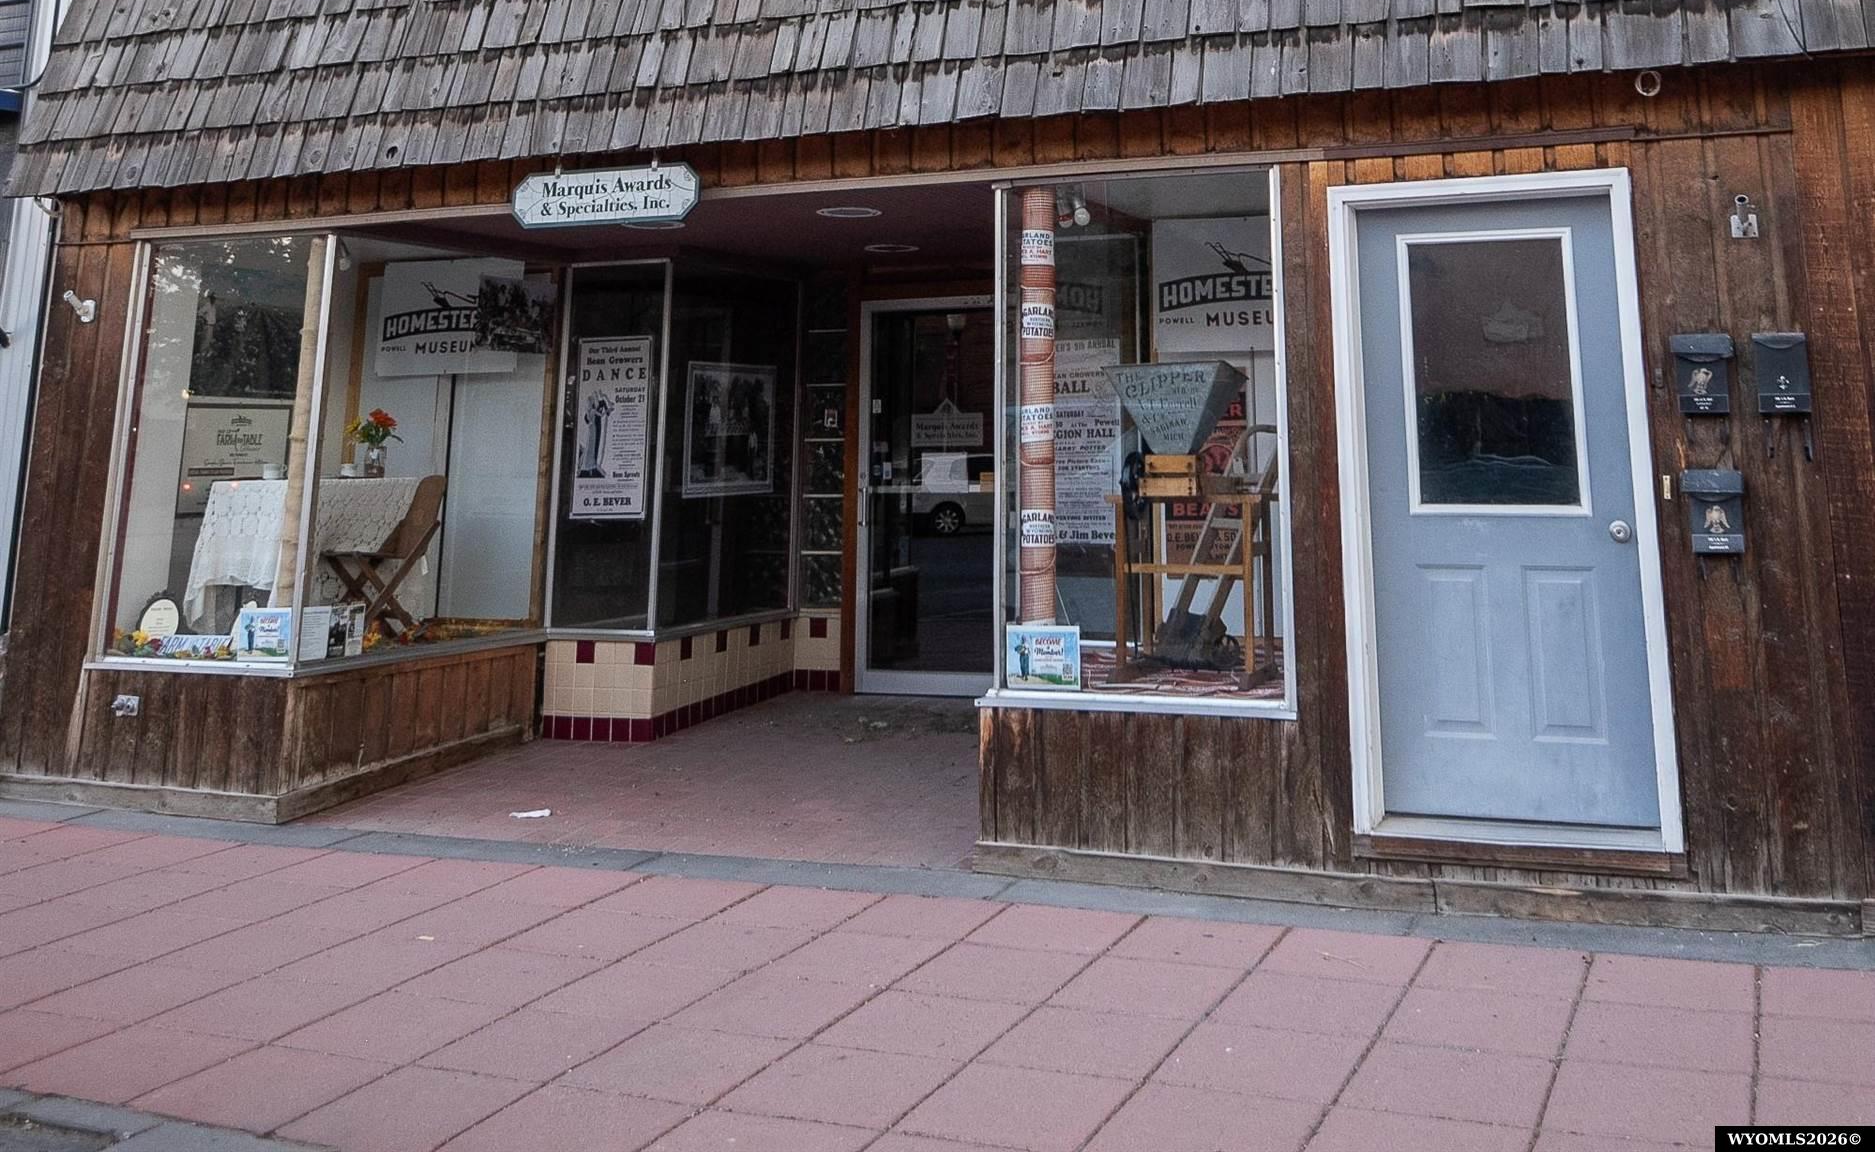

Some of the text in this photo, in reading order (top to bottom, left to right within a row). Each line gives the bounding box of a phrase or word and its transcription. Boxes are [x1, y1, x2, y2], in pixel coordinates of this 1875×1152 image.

[542, 174, 672, 198] Marquis Awards
[540, 204, 552, 216] &
[643, 195, 670, 210] Inc.
[1162, 275, 1272, 308] HOMESTE
[1159, 310, 1273, 327] POWELL MUSEU
[609, 356, 643, 364] Growers
[583, 367, 646, 381] DANCE
[1054, 380, 1090, 394] BALL
[1125, 370, 1206, 398] CLIPPER
[1056, 410, 1084, 418] SATURDAY
[1087, 428, 1115, 438] HALL
[1173, 502, 1240, 517] BEAS
[1069, 530, 1088, 539] Jim
[1091, 531, 1115, 539] Beve
